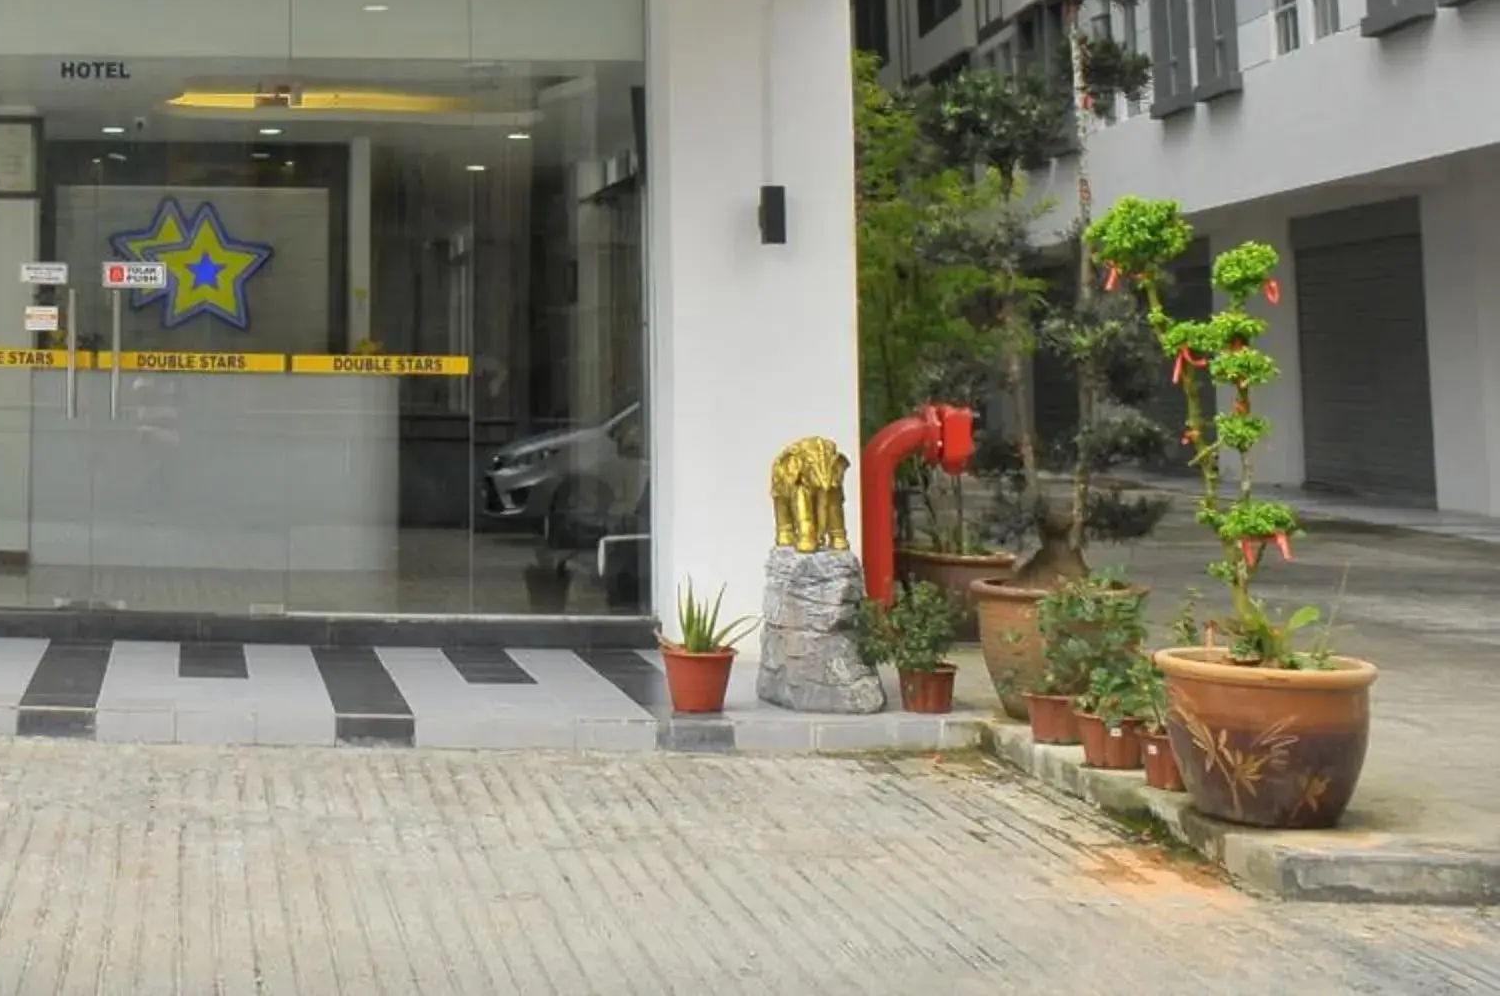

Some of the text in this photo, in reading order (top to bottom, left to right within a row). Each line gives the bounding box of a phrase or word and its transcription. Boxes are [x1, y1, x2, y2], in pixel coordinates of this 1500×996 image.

[61, 61, 131, 79] HOTEL
[7, 351, 55, 366] STARS
[136, 354, 247, 370] DOUBLE STARS
[333, 356, 444, 373] DOUBLE STARS
